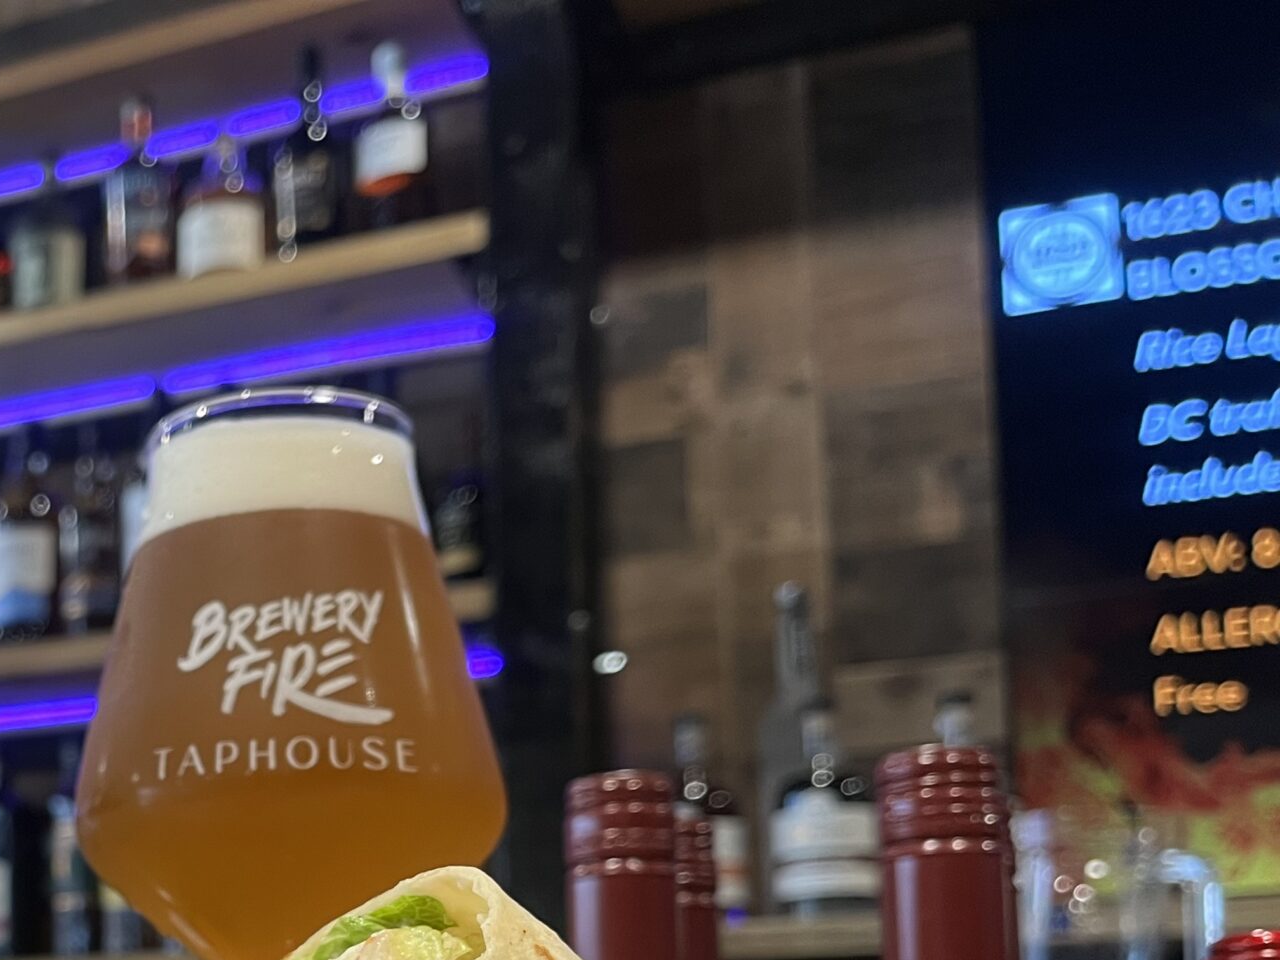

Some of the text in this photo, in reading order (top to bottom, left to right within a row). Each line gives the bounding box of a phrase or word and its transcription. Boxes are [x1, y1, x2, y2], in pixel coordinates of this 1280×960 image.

[1133, 327, 1224, 373] Rice
[1138, 398, 1209, 447] BC
[1145, 530, 1247, 581] ABV:
[176, 591, 384, 673] BREWERY
[1149, 604, 1280, 656] ALLER
[220, 639, 396, 727] FIRE
[1153, 675, 1248, 717] Free
[153, 735, 420, 781] TAPHOUSE
